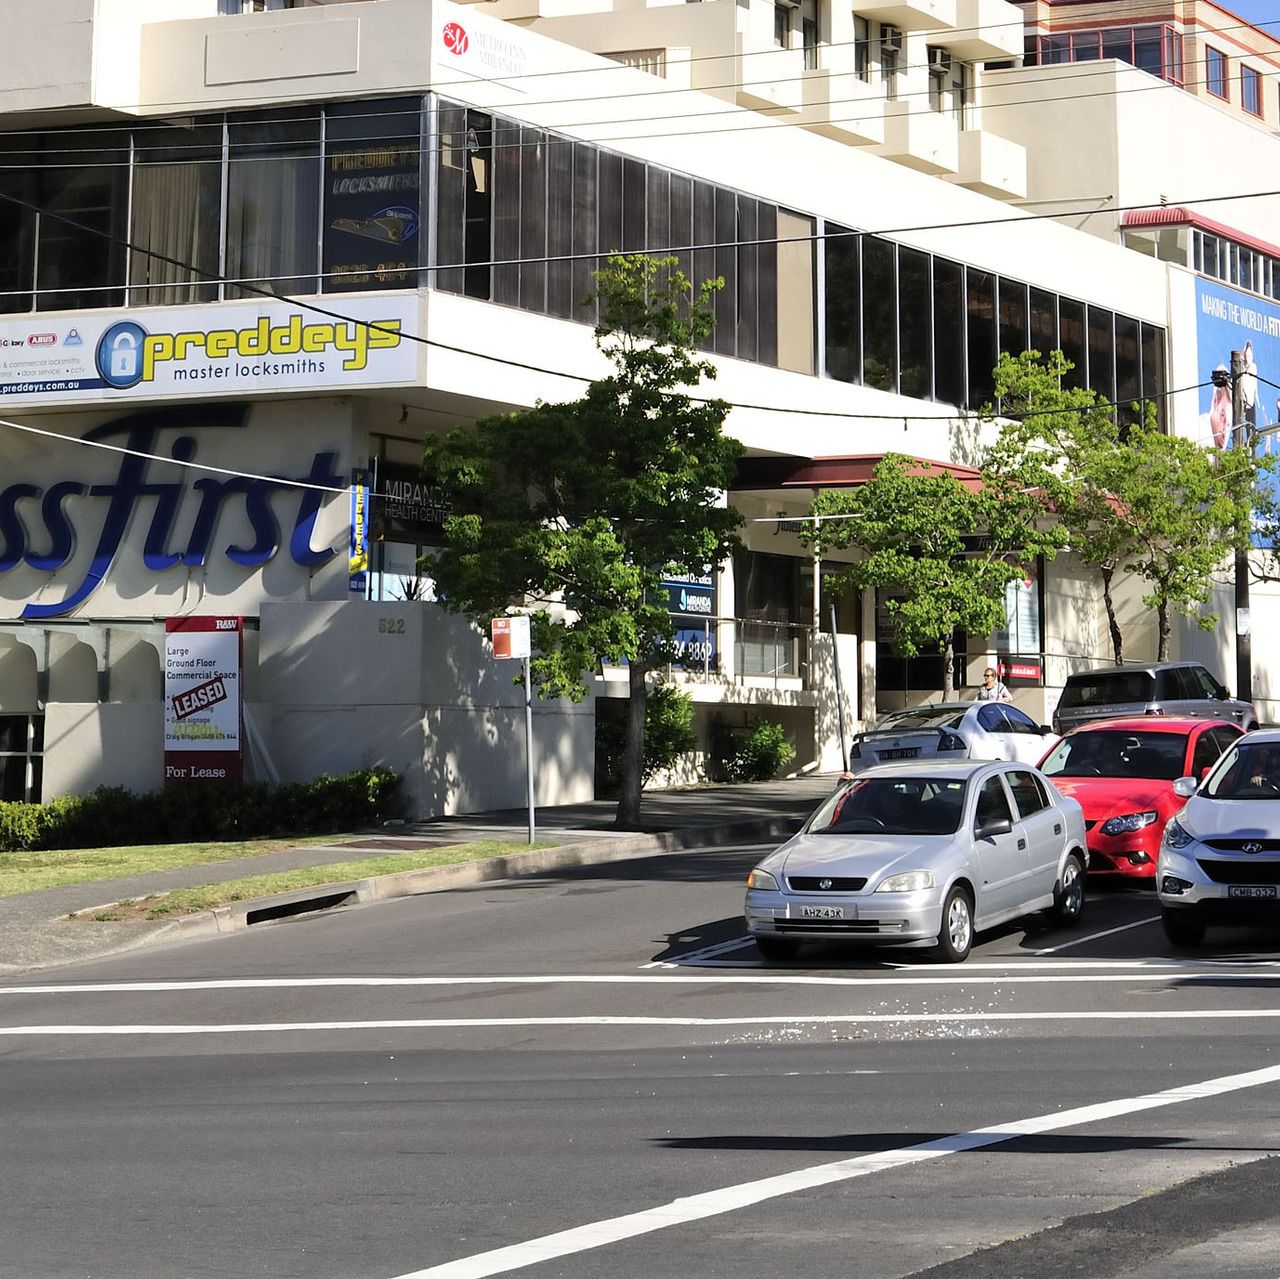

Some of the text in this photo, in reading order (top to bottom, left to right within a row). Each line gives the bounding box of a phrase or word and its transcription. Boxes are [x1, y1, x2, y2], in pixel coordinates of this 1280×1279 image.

[1201, 293, 1227, 320] MAKING
[1227, 302, 1240, 325] THE
[1240, 307, 1263, 332] WORLD
[1263, 315, 1269, 335] A
[141, 314, 403, 383] preddeys
[9, 359, 48, 369] commercial
[173, 357, 326, 381] master locksmiths
[384, 503, 418, 520] HEALTH
[378, 618, 406, 634] 522
[167, 647, 189, 656] Large
[166, 658, 216, 668] Ground Floor
[166, 671, 237, 681] Commercial Space
[174, 680, 226, 717] LEASED
[165, 766, 226, 778] For Lease
